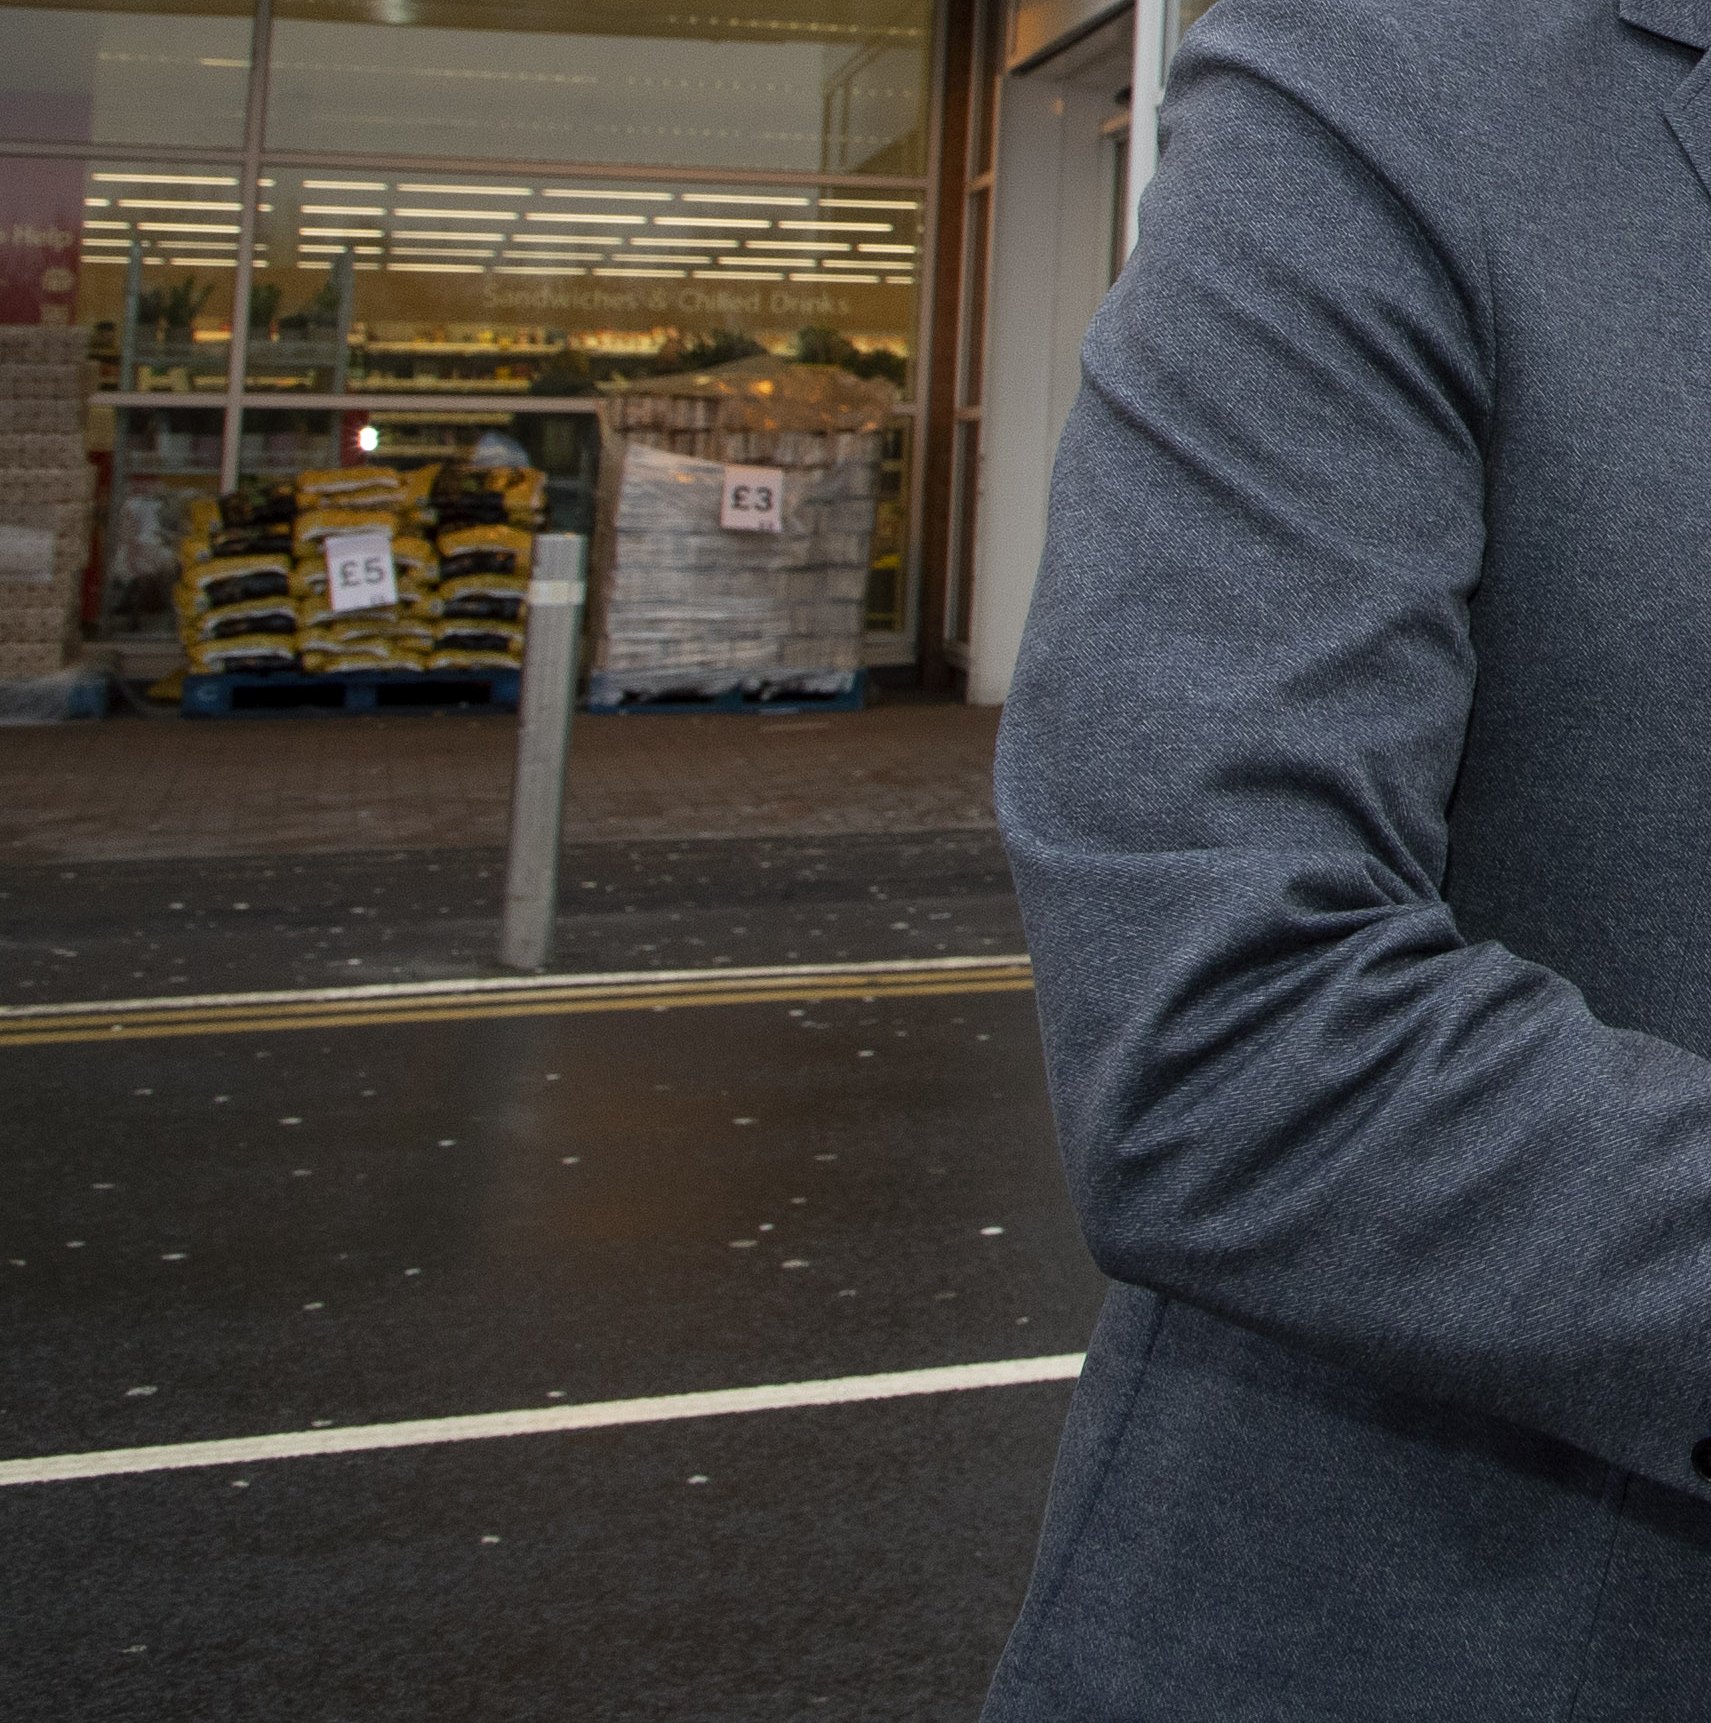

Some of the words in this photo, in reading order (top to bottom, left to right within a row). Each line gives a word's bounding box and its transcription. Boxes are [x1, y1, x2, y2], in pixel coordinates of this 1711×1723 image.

[483, 280, 640, 310] Sandwiches
[679, 286, 760, 313] Chilled
[770, 290, 852, 315] Drinks
[733, 485, 774, 511] £3
[341, 557, 384, 587] £5
